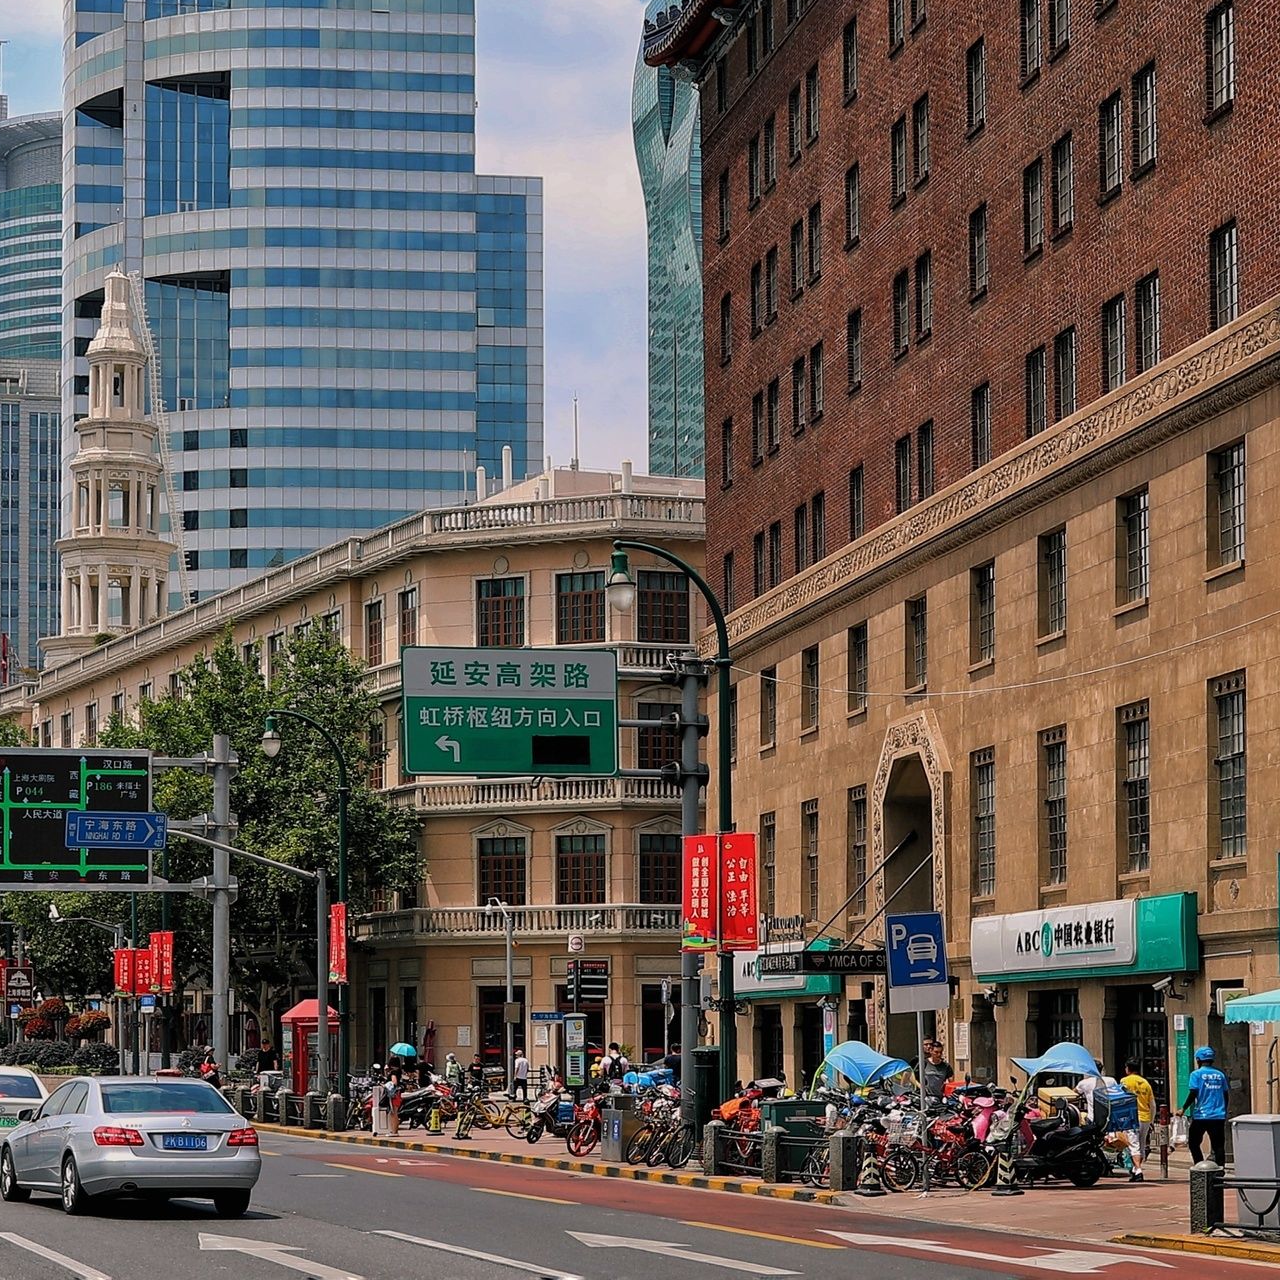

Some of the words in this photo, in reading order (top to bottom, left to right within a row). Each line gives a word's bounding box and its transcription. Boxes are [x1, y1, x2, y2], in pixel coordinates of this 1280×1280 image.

[430, 660, 590, 689] 延安高架路
[420, 706, 601, 728] 虹桥枢纽方向入口
[103, 759, 133, 769] 汉口路
[13, 774, 56, 783] 上海大剧院
[86, 782, 93, 790] P
[94, 782, 113, 791] 186
[16, 787, 23, 796] P
[24, 787, 44, 796] 044
[120, 790, 138, 799] 广场
[22, 810, 63, 820] 人民大道
[84, 820, 137, 832] 宁海东路
[726, 858, 736, 882] 公正
[738, 858, 749, 882] 自由
[726, 890, 737, 917] 法治
[738, 889, 749, 917] 平等
[891, 924, 907, 950] P
[1054, 918, 1115, 948] 中国农业银行
[1016, 930, 1040, 954] ABC
[827, 955, 856, 968] YMCA
[859, 955, 874, 967] OF
[165, 1136, 206, 1147] 沪KB1106
